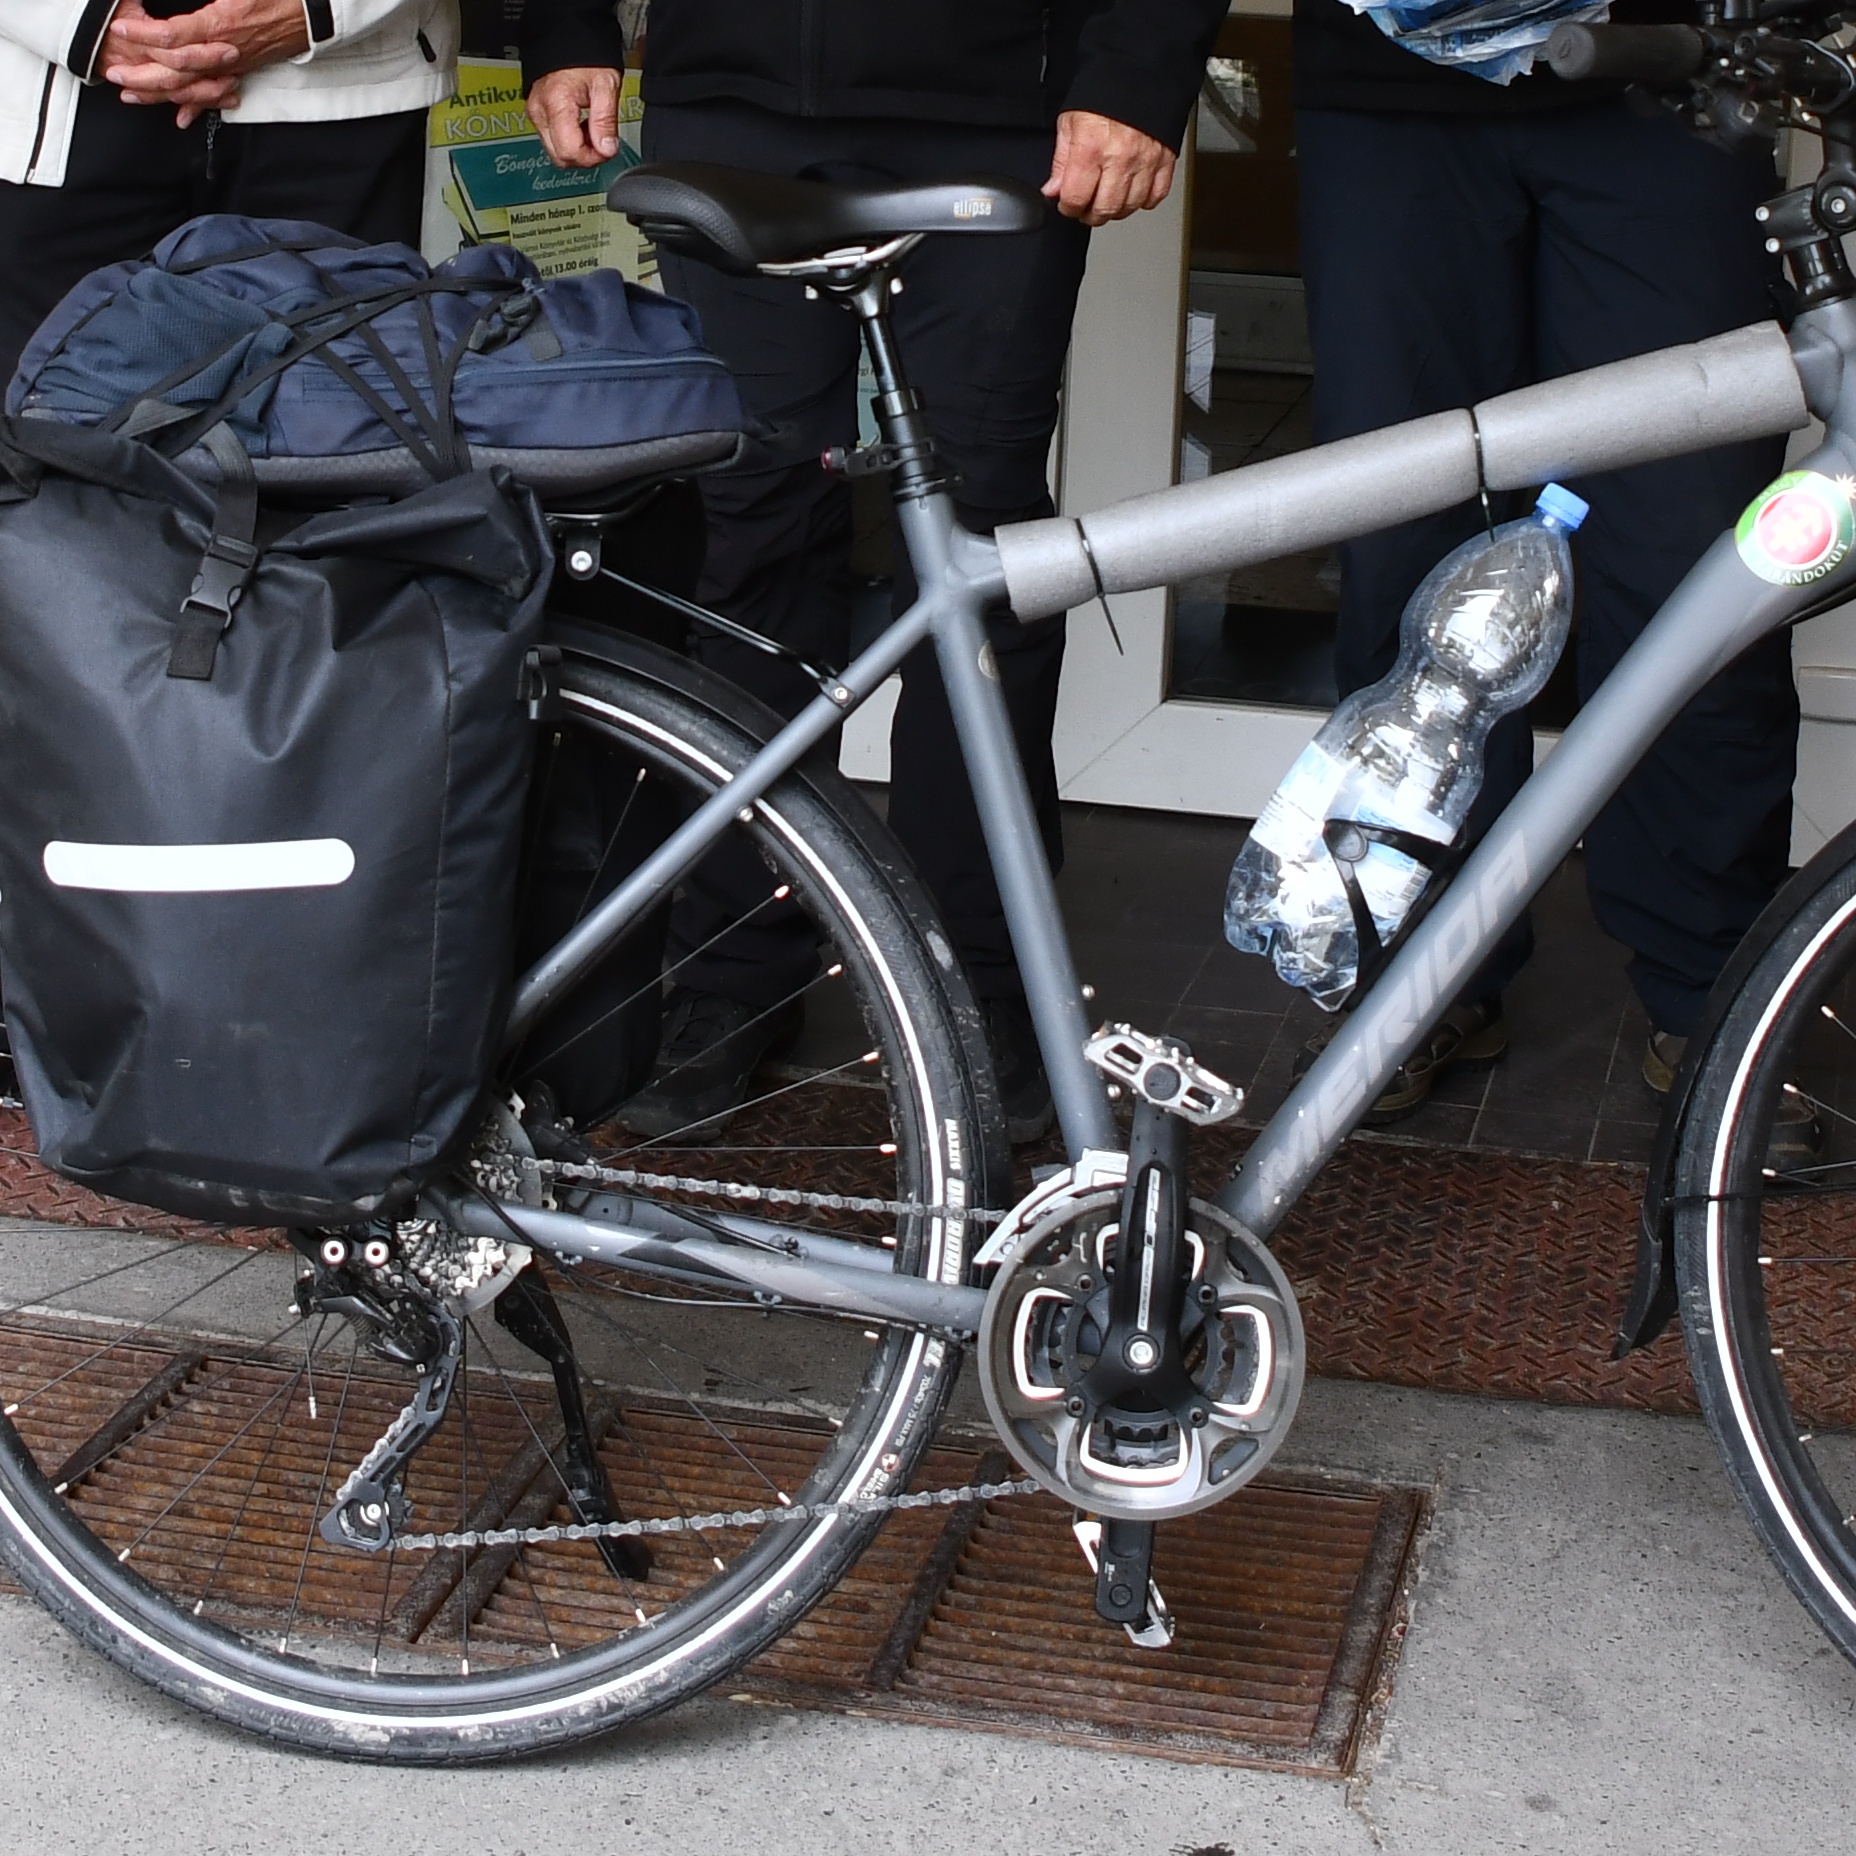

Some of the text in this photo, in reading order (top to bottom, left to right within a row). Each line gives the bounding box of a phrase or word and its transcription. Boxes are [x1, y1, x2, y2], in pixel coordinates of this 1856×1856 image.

[510, 211, 546, 225] Minden
[548, 207, 576, 223] hónap
[554, 260, 578, 274] 13.00
[1256, 829, 1529, 1214] MERIDA
